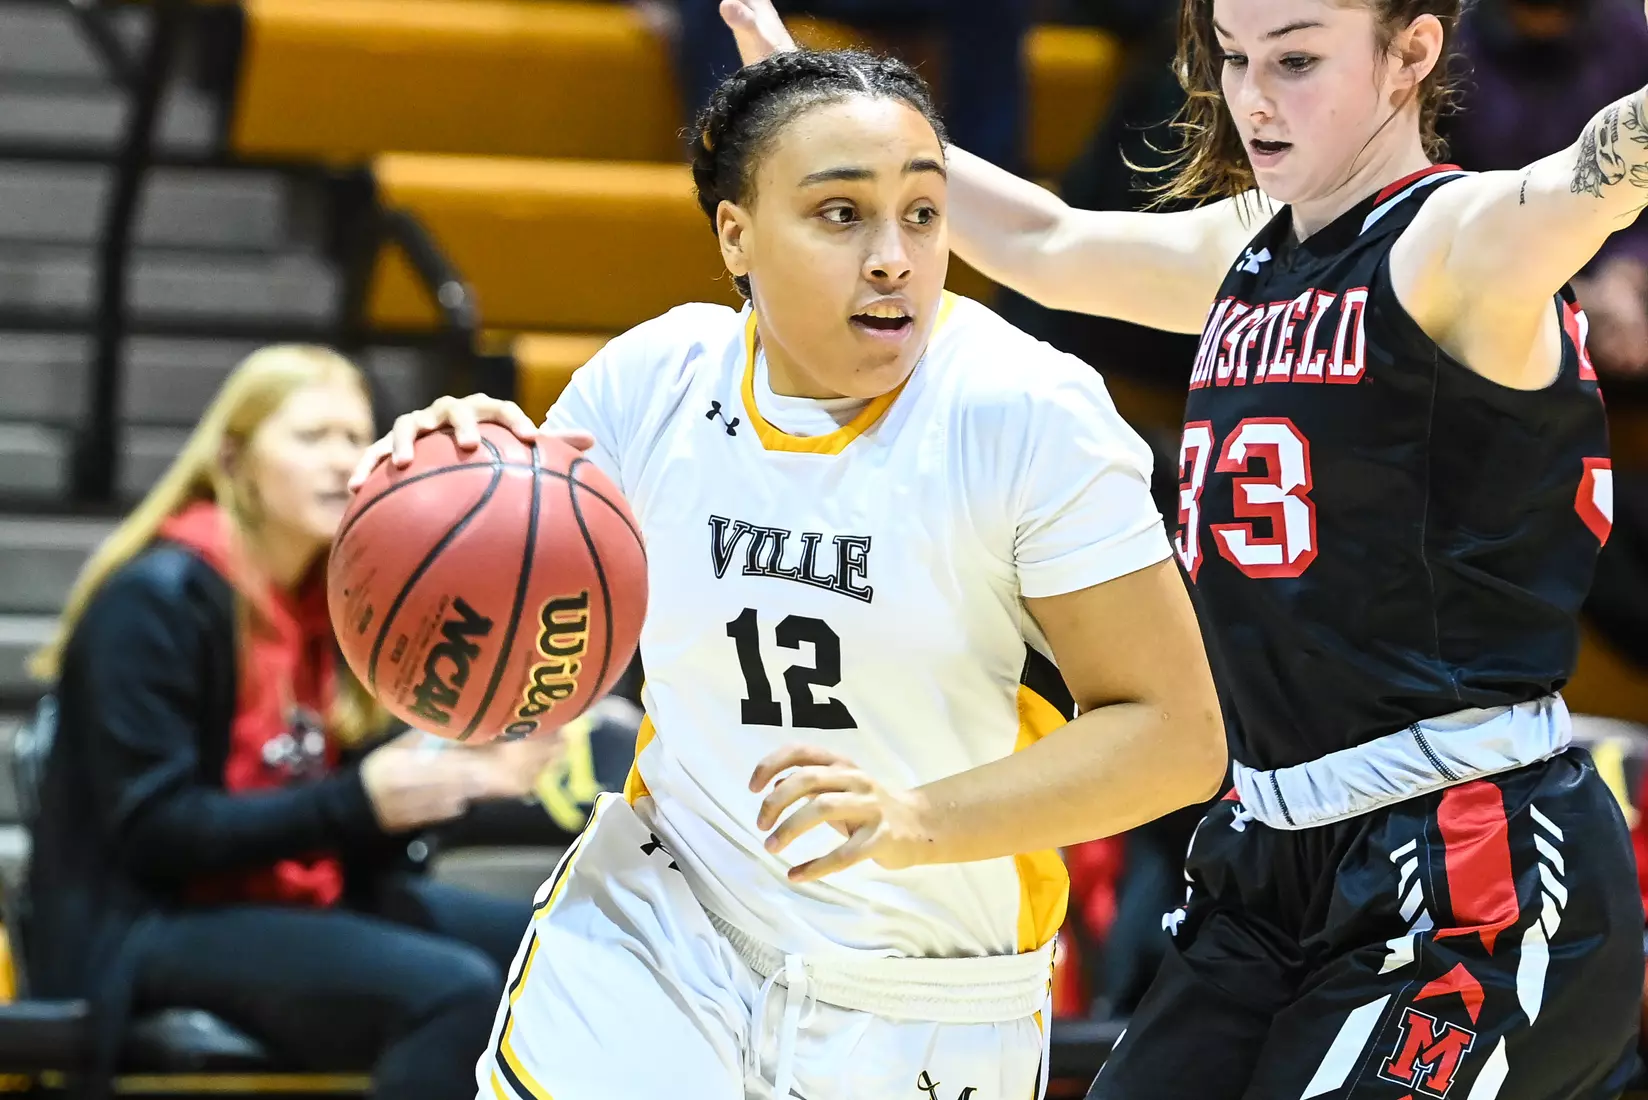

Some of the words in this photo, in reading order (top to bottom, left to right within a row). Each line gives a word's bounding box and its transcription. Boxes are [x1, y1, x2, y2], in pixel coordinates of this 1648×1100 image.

[1189, 286, 1369, 390] ANSFIELD
[1175, 417, 1319, 585] 33
[708, 514, 874, 604] VILLE
[405, 596, 494, 726] NCAA
[726, 607, 858, 729] 12
[1377, 1007, 1477, 1099] M
